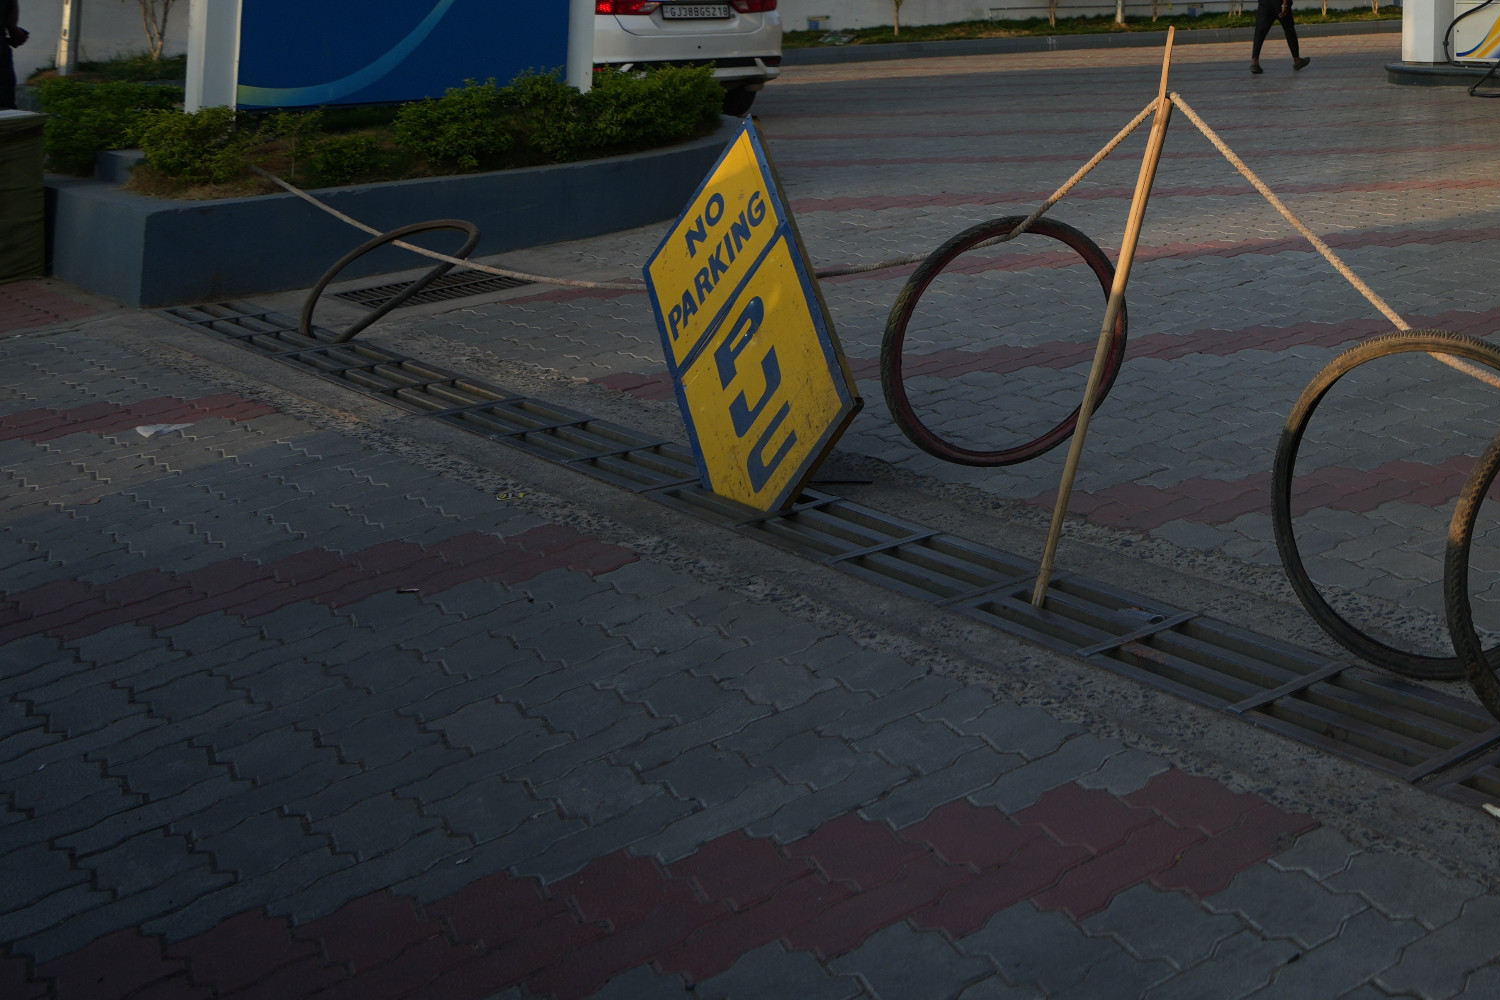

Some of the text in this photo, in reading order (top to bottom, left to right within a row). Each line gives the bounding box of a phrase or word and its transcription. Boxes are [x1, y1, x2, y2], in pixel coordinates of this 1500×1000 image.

[667, 190, 767, 342] PARKING
[684, 192, 725, 259] NO
[713, 295, 798, 494] PUC
